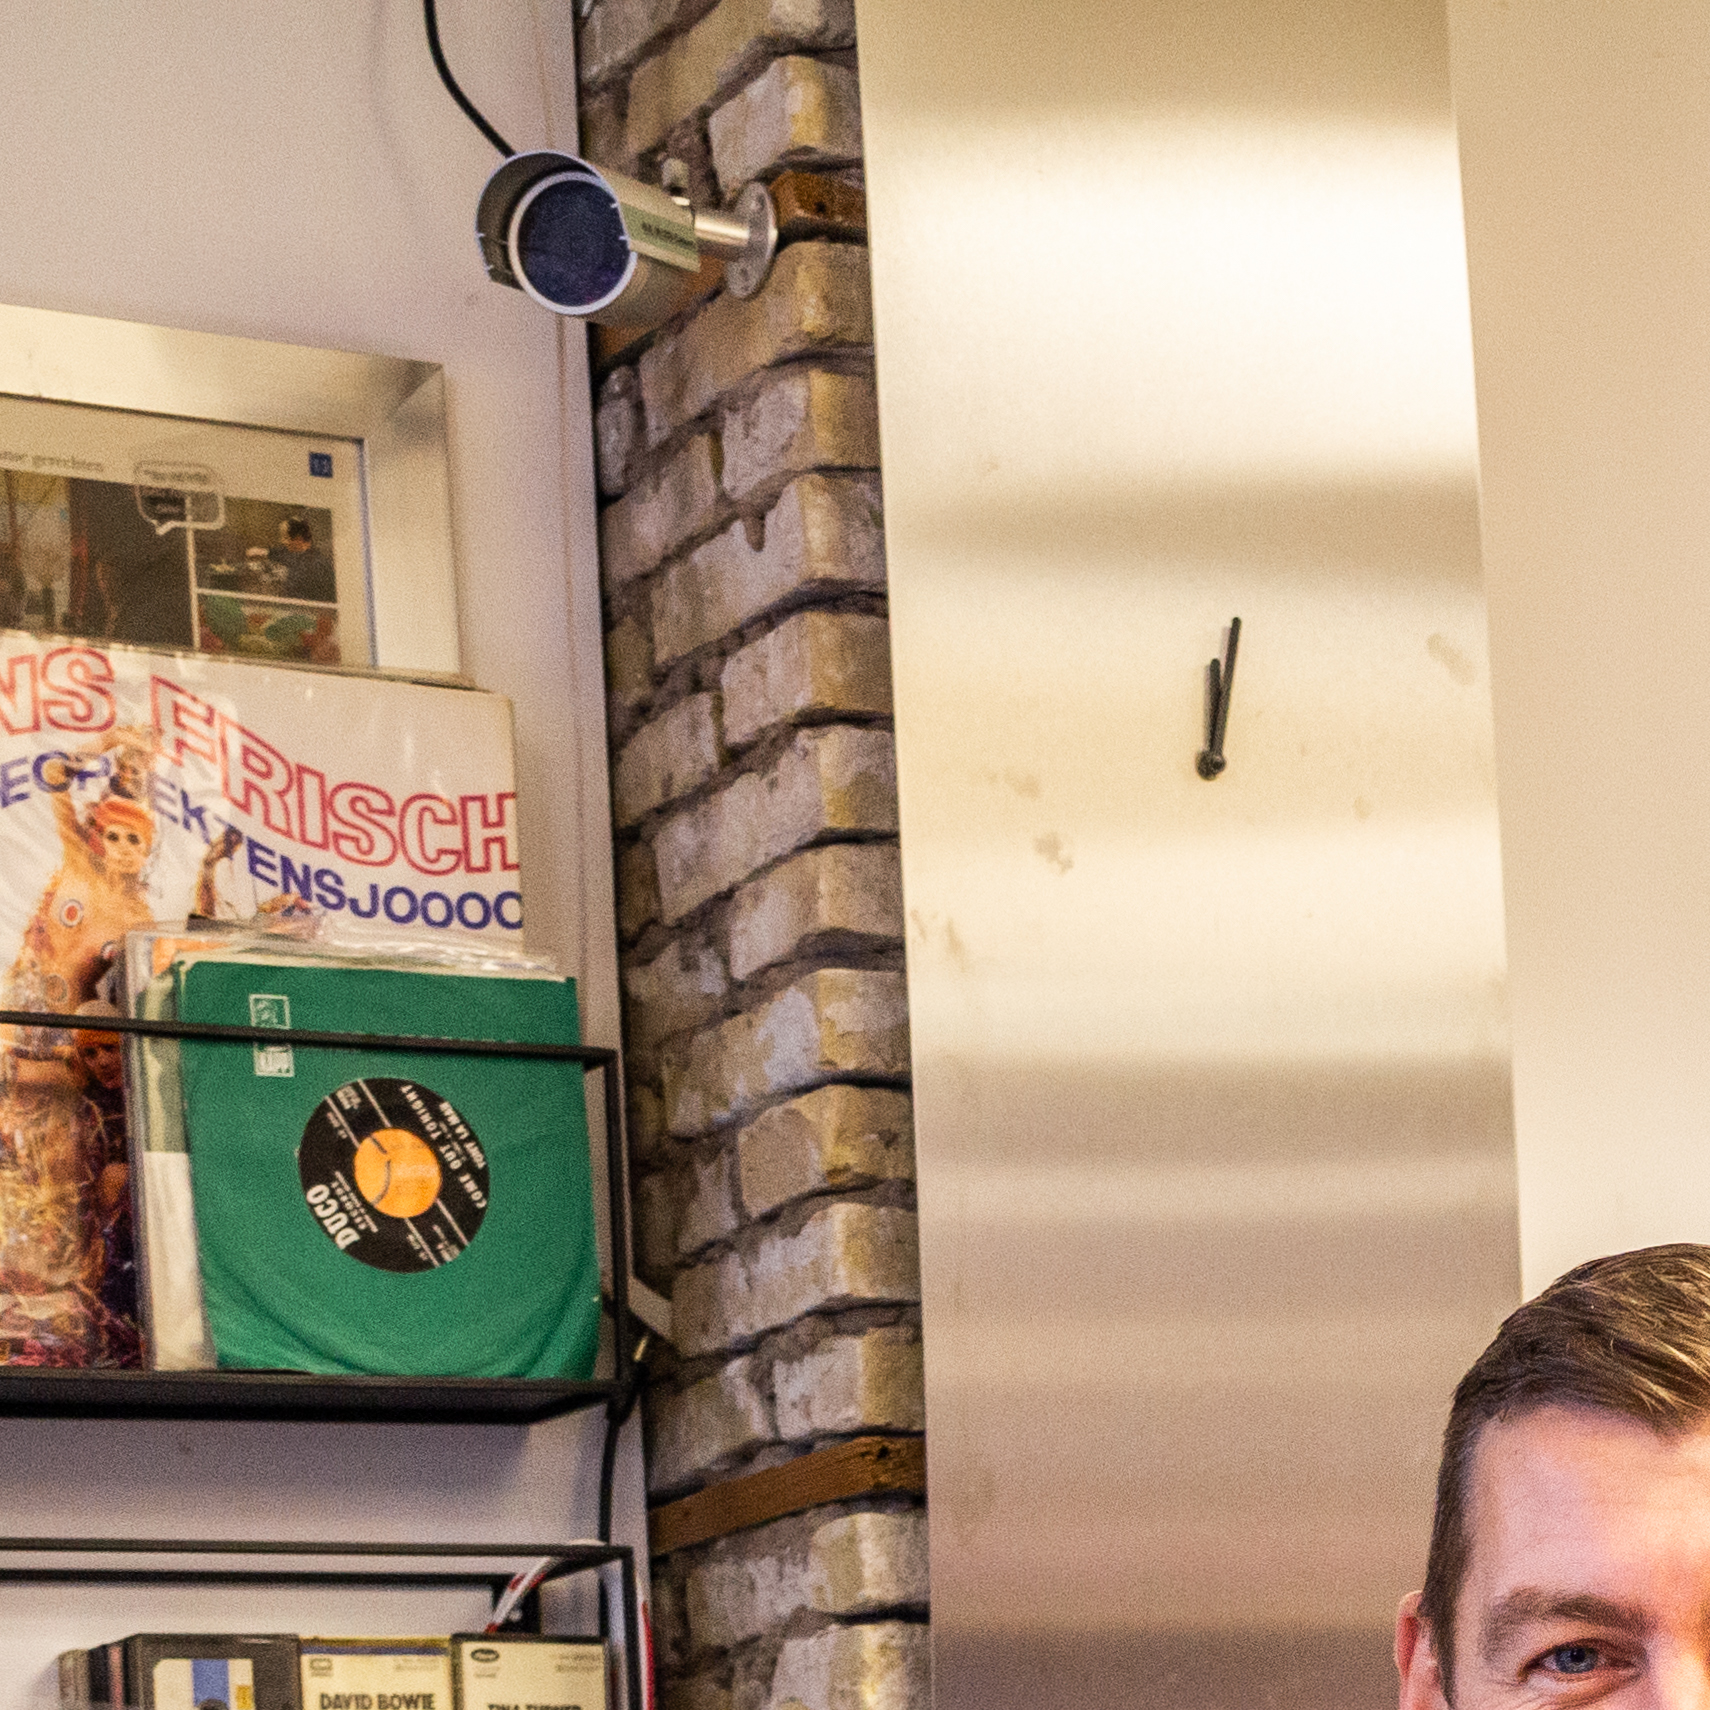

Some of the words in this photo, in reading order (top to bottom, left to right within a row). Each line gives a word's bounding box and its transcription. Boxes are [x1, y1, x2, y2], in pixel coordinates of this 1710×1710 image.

[150, 674, 520, 877] FRISCH
[400, 1084, 444, 1141] TONIGHT
[438, 1143, 463, 1170] OUT
[306, 1183, 362, 1251] DUCO
[458, 1172, 488, 1210] COME
